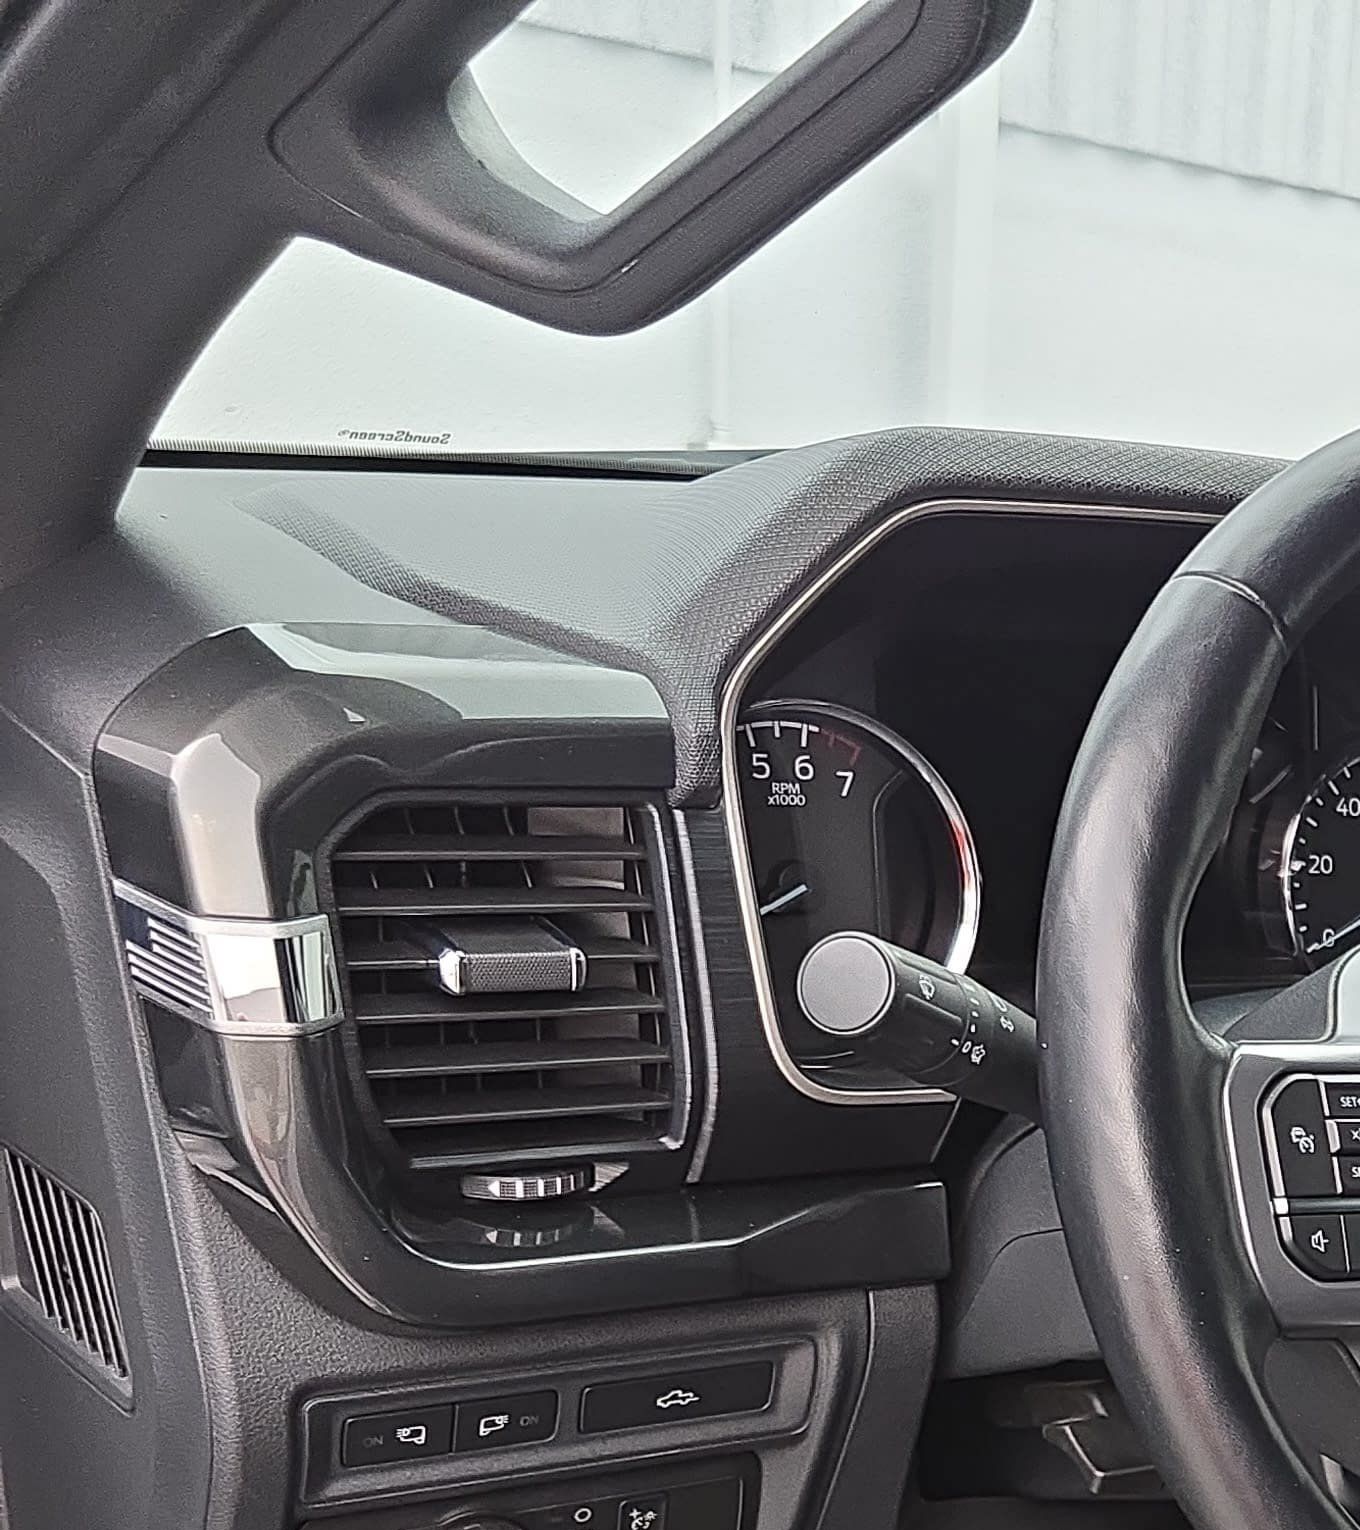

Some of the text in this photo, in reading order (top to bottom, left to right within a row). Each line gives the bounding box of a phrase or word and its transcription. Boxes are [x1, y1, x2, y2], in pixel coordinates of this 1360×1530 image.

[752, 753, 770, 779] 5
[794, 755, 814, 780] 6
[771, 782, 801, 794] RPM
[836, 771, 854, 797] 7
[767, 794, 806, 806] x1000
[1308, 855, 1333, 874] 20
[518, 1415, 539, 1427] ON
[363, 1436, 384, 1448] ON
